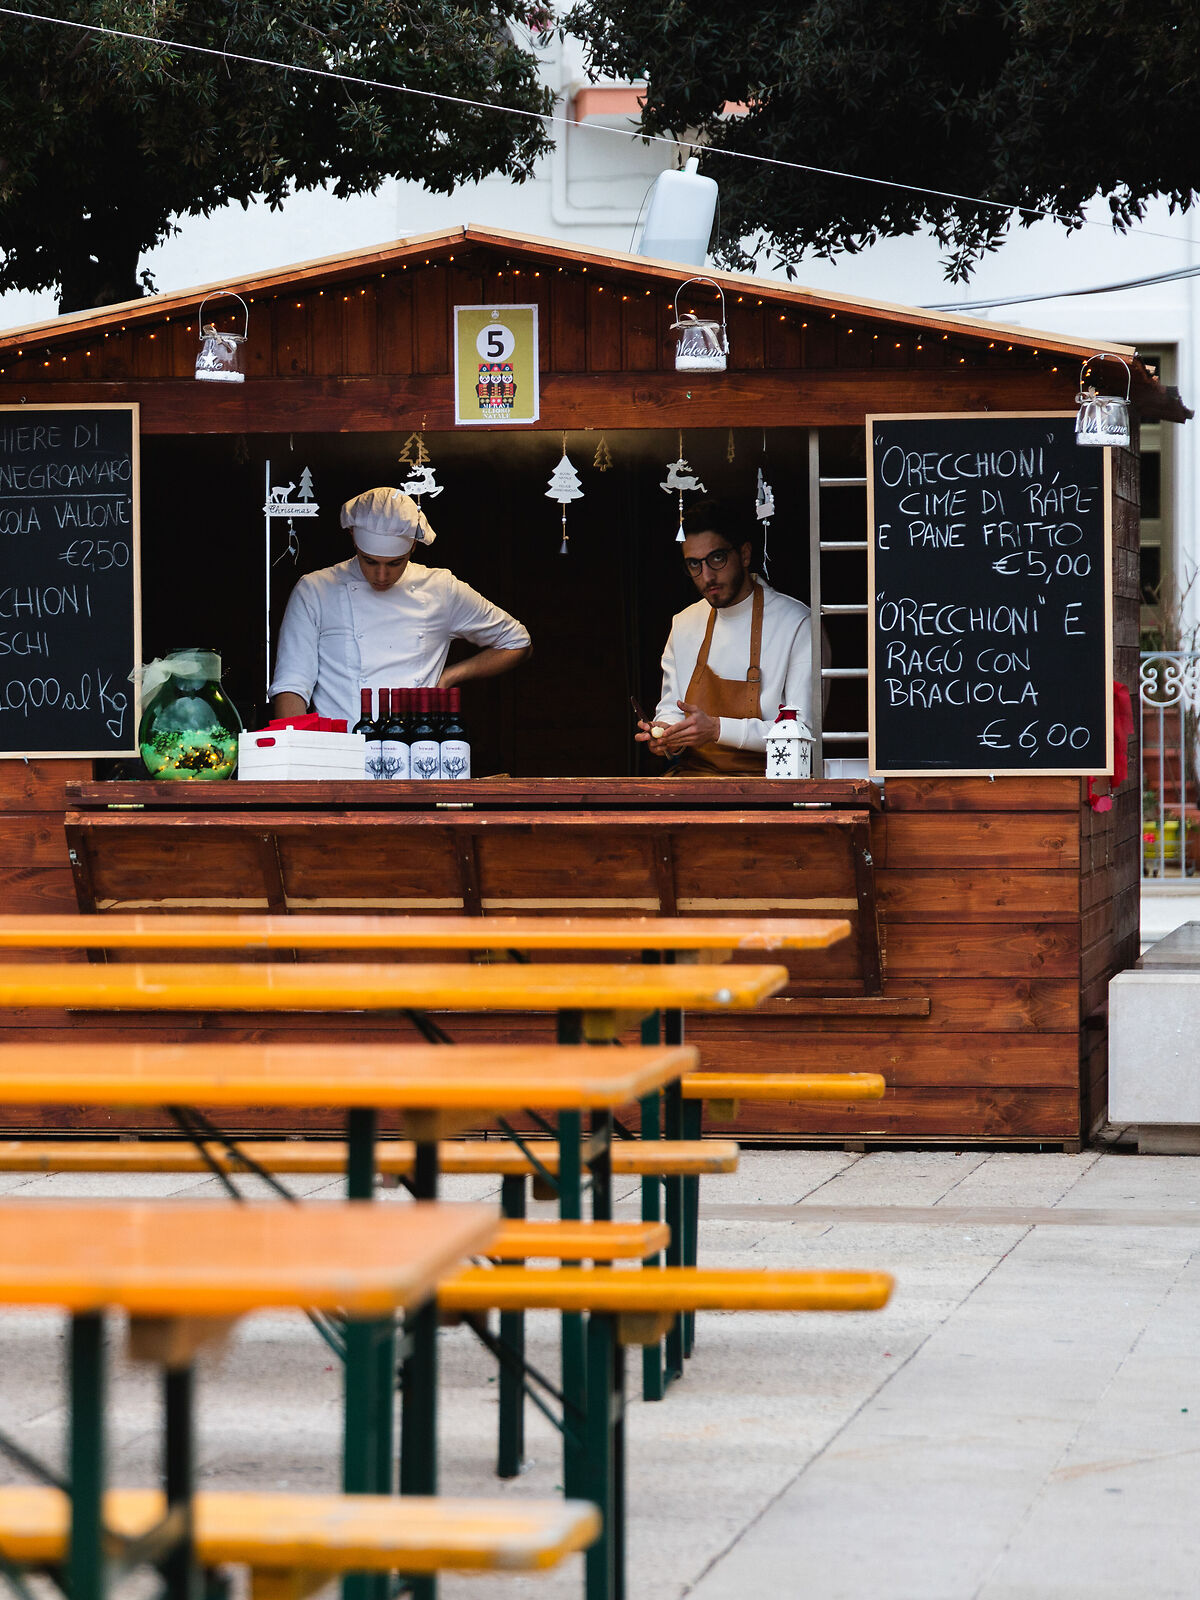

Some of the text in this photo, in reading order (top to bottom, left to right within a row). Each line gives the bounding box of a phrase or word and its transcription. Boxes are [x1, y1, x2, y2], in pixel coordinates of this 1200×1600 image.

[487, 331, 505, 357] 5
[74, 423, 100, 449] DI
[899, 489, 967, 516] CIME
[982, 489, 1005, 515] DI
[878, 520, 1084, 549] E PANE FRITTO
[58, 540, 130, 573] €2,50
[1065, 602, 1087, 635] E
[976, 648, 1031, 672] CON
[885, 678, 1040, 708] BRACIOLA
